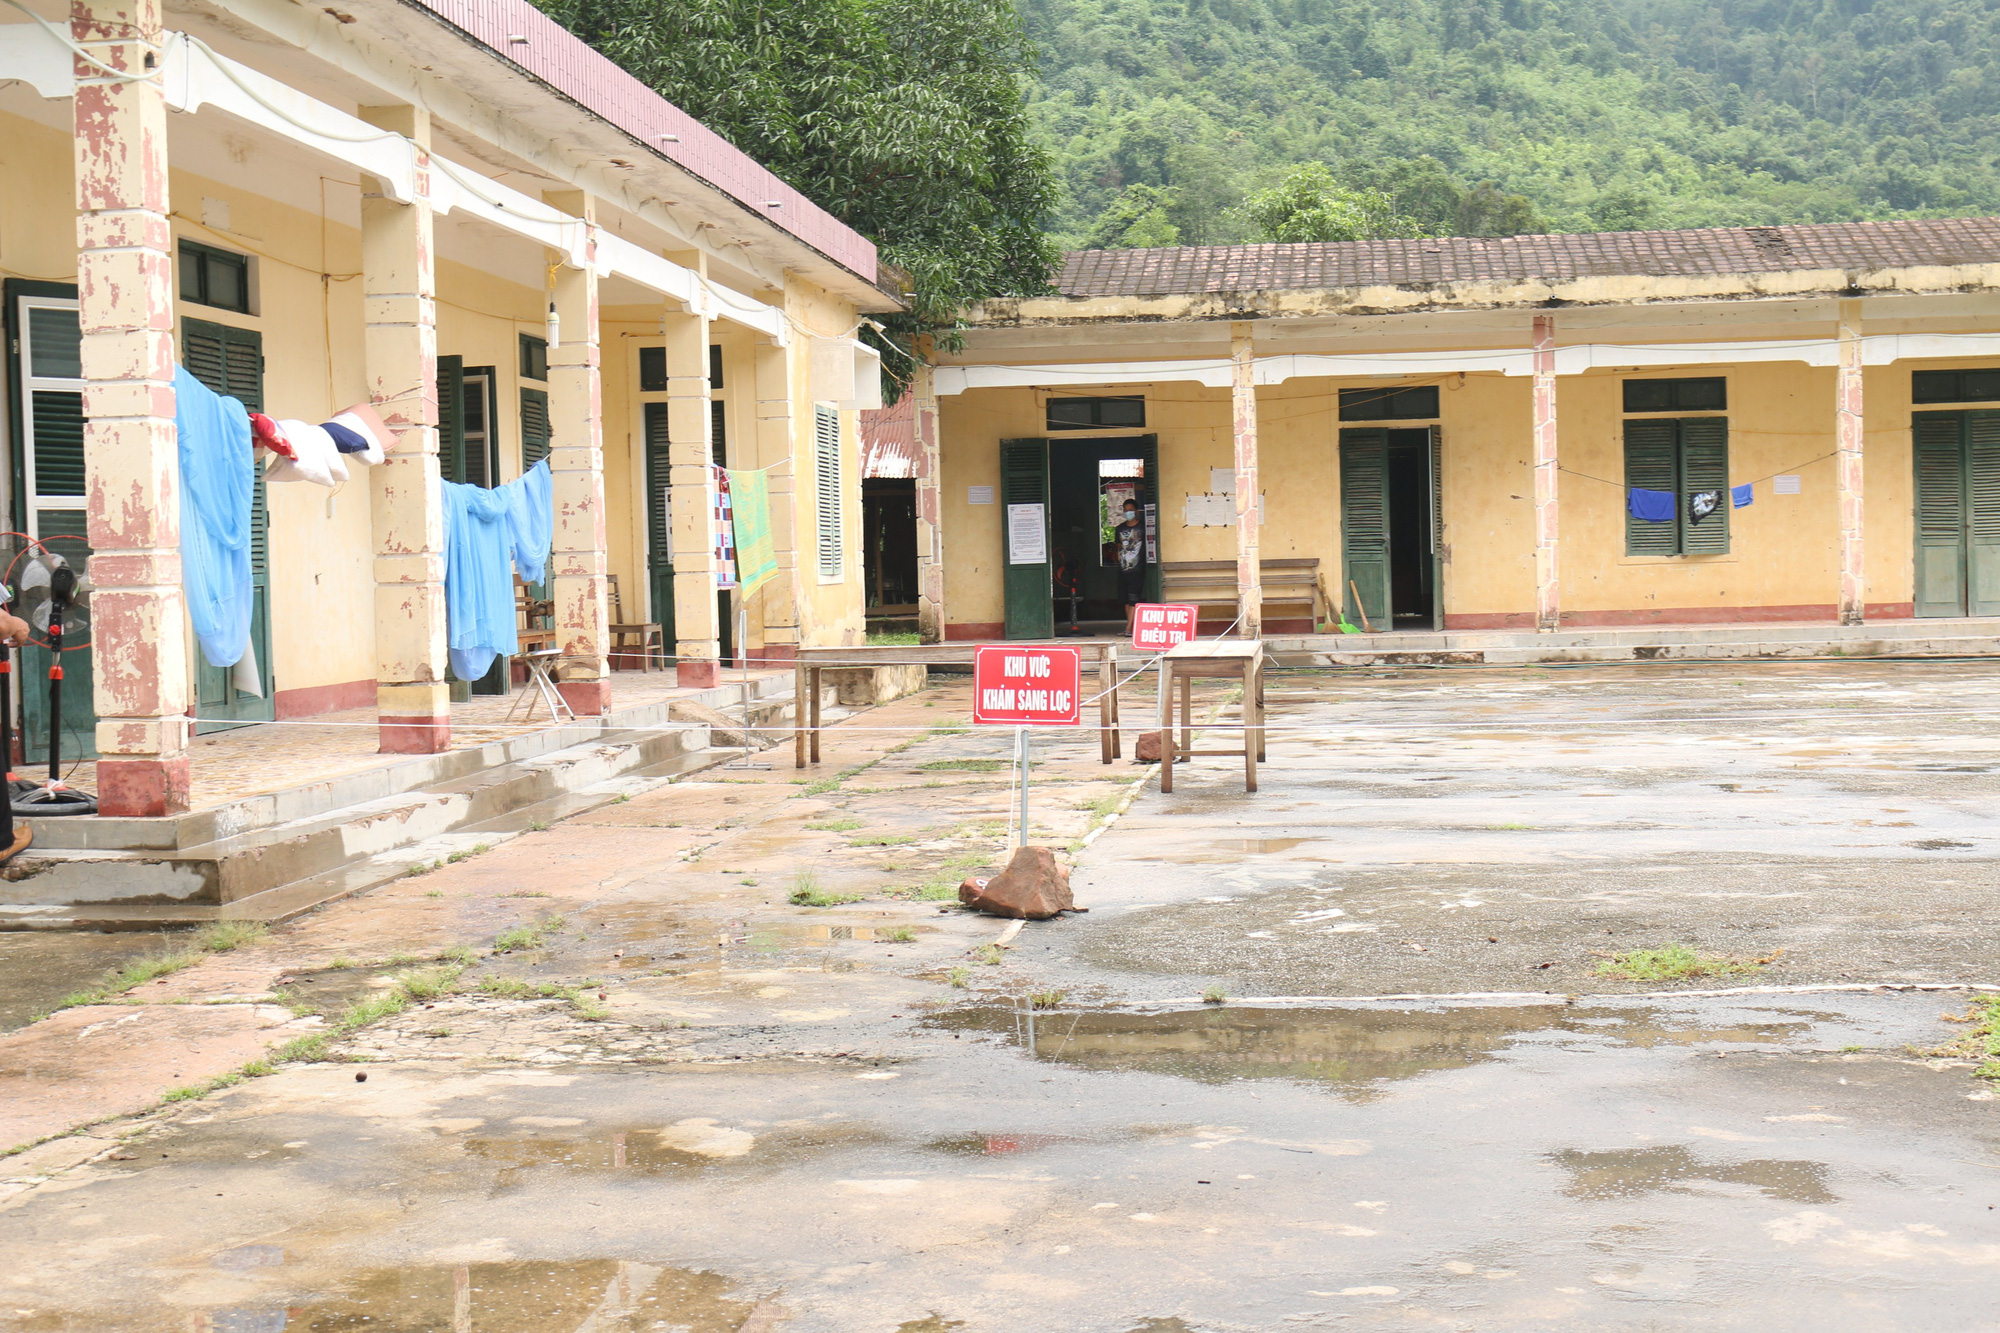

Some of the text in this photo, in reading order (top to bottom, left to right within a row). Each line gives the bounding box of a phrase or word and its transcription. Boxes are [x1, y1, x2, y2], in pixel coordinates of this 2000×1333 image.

[1142, 610, 1164, 623] KHU
[1004, 656, 1027, 677] KHU
[1017, 682, 1048, 711] SÀNG
[1050, 690, 1071, 714] LỌC
